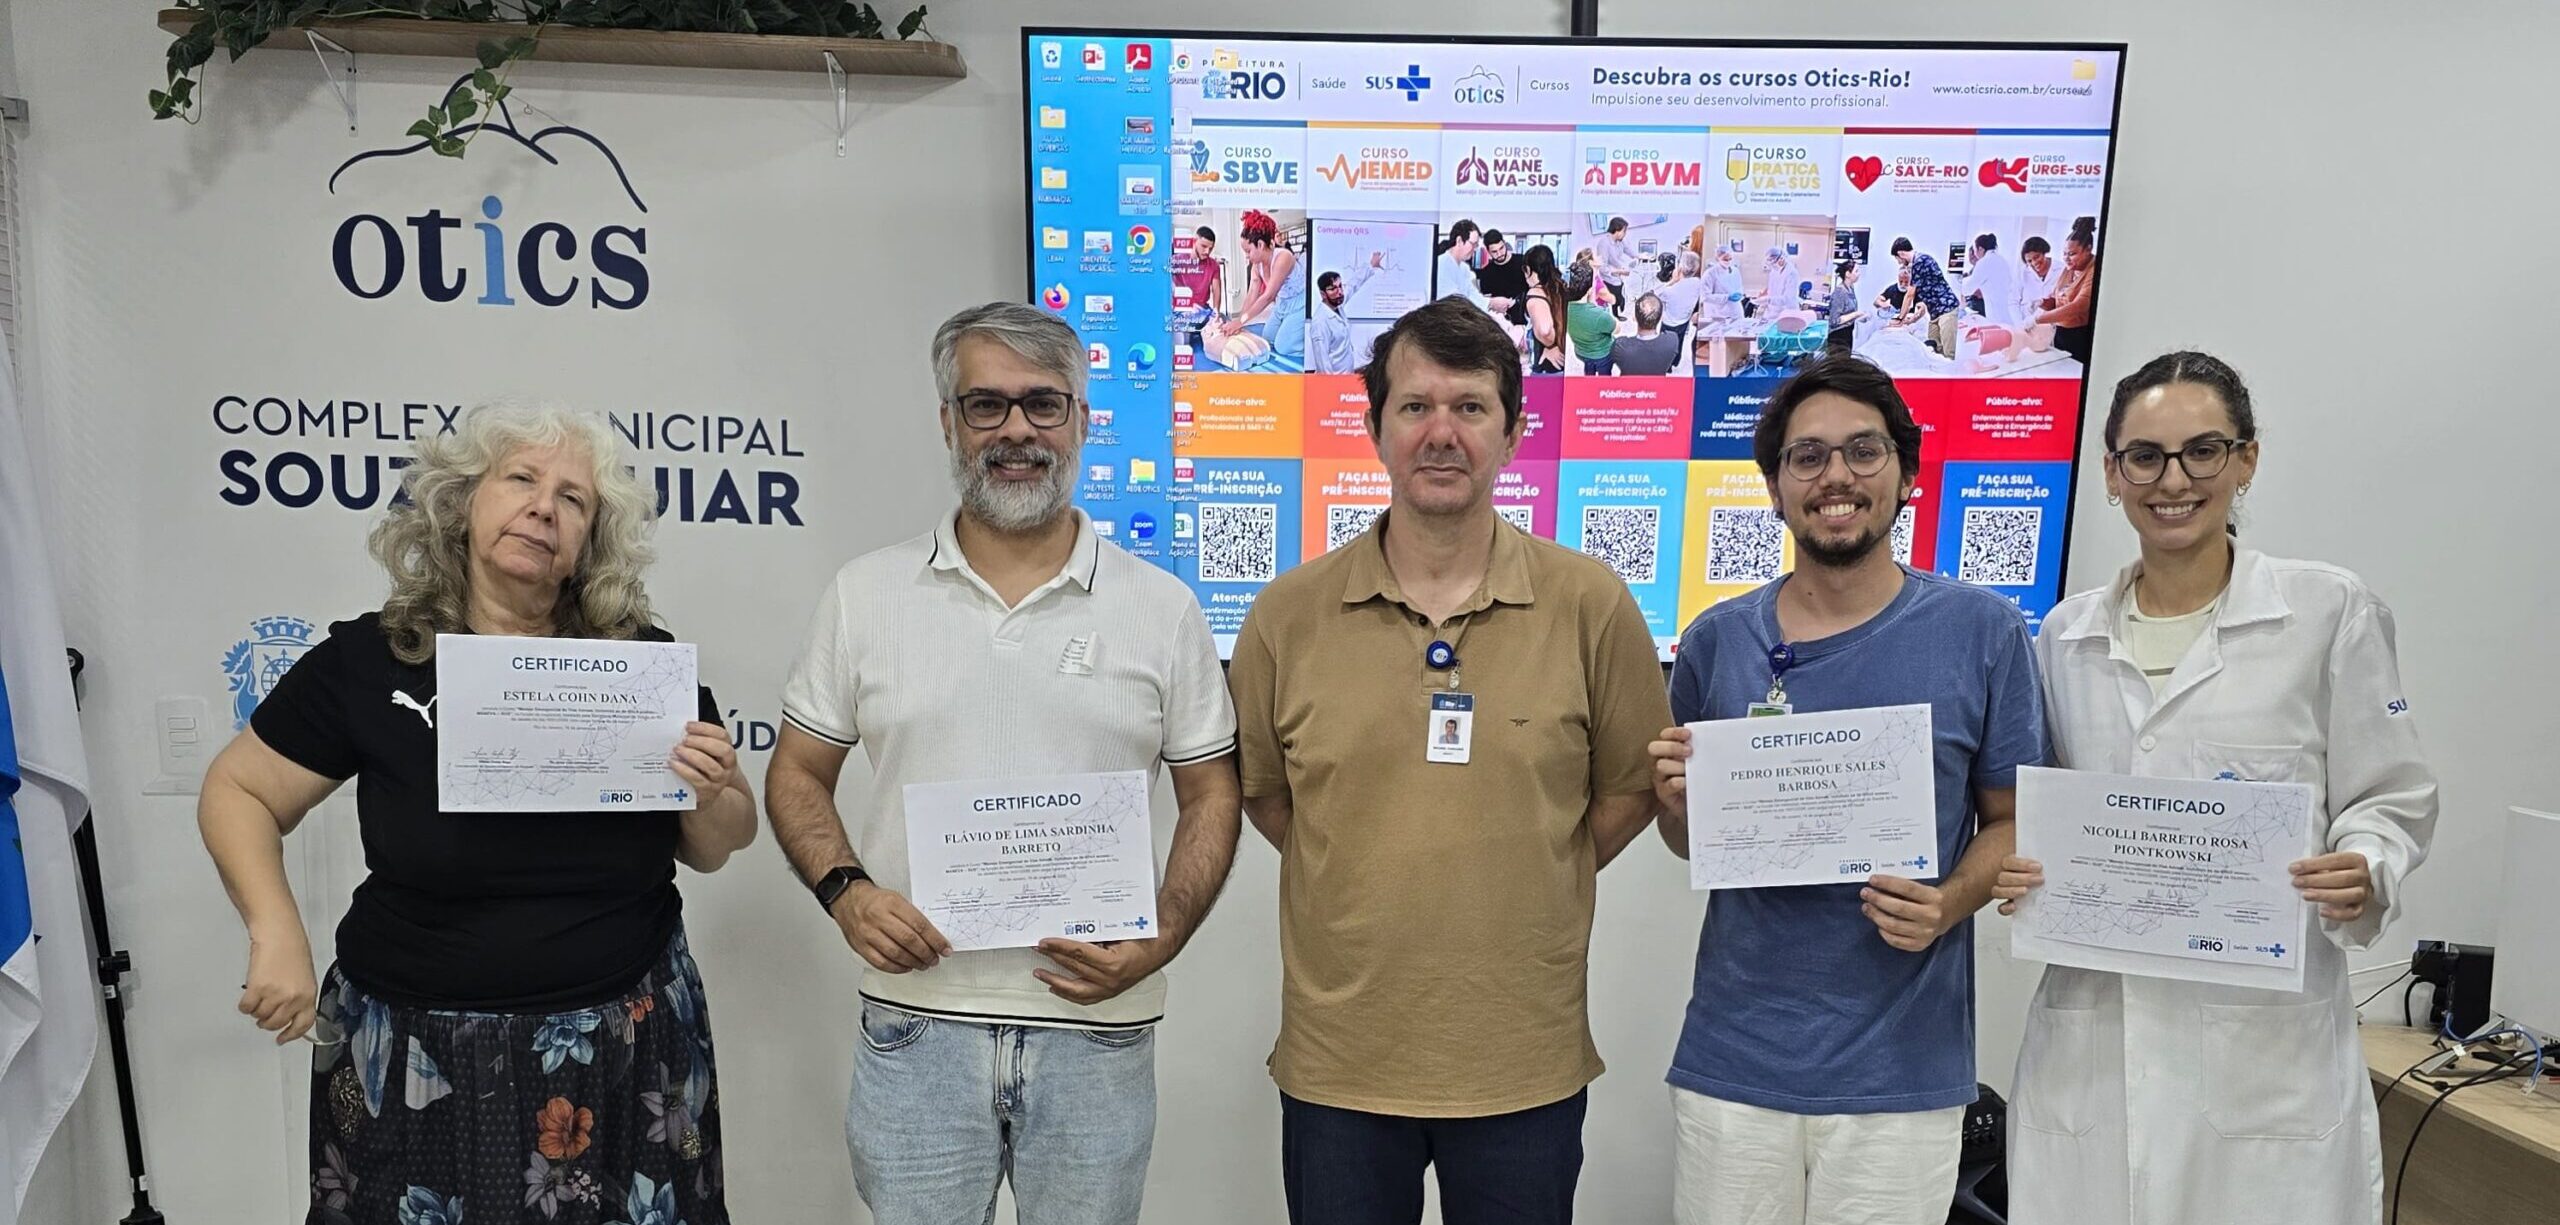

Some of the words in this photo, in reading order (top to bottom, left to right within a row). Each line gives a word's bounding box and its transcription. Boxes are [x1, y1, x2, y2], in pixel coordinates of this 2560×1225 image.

[1202, 59, 1285, 68] PEITURA
[1311, 77, 1346, 89] Saúde
[1365, 76, 1394, 90] SUS
[1592, 66, 1692, 87] Descubra
[1699, 71, 1722, 87] os
[1728, 71, 1798, 88] cursos
[1804, 68, 1911, 89] Otics-Rio!
[1231, 71, 1286, 100] RIO
[1530, 79, 1570, 91] Cursos
[1454, 85, 1505, 104] otics
[1591, 93, 1663, 108] Impulsione
[1667, 95, 1690, 106] seu
[1694, 93, 1807, 107] desenvolvimento
[1810, 94, 1889, 109] profissional.
[1224, 147, 1272, 158] CURSO
[1361, 148, 1408, 159] CURSO
[1494, 147, 1540, 158] CURSO
[1612, 149, 1660, 160] CURSO
[1753, 147, 1806, 160] CURSO
[2032, 155, 2066, 163] CURSO
[1493, 159, 1543, 172] MANE
[1896, 156, 1930, 165] CURSO
[1223, 161, 1298, 184] SBVE
[1360, 161, 1433, 181] IEMED
[1610, 162, 1702, 186] PBVM
[1895, 165, 1969, 177] SAVE-RIO
[2032, 164, 2102, 176] URGE-SUS
[1493, 174, 1559, 187] VA-SUS
[1752, 176, 1821, 189] VA-SUS
[331, 195, 649, 310] otics
[1599, 390, 1656, 400] Público-alvo:
[1985, 397, 2043, 406] Público-alvo:
[213, 395, 462, 441] COMPLEX
[608, 410, 805, 457] NICIPAL
[219, 449, 418, 511] SOUZ
[1208, 470, 1242, 483] FAÇA
[1242, 471, 1266, 481] SUA
[1338, 472, 1369, 484] FAÇA
[1499, 473, 1523, 483] SUA
[1595, 474, 1626, 486] FAÇA
[1627, 474, 1650, 484] SUA
[1978, 475, 2009, 488] FAÇA
[2010, 475, 2033, 485] SUA
[1322, 483, 1392, 499] PRÉ-INSCRIÇ
[1578, 485, 1668, 499] PRÉ-INSCRIÇÃO
[1961, 486, 2049, 500] PRÉ-INSCRIÇÃO
[512, 657, 628, 673] CERTIFICADO
[503, 691, 555, 702] ESTELA
[600, 693, 638, 704] DANA
[2387, 698, 2408, 715] SU
[1750, 729, 1862, 750] CERTIFICADO
[1730, 768, 1773, 781] PEDRO
[1776, 764, 1842, 778] HENRIQUE
[1845, 760, 1887, 773] SALES
[1778, 779, 1838, 793] BARBOSA
[611, 793, 633, 803] RIO
[973, 793, 1082, 812] CERTIFICADO
[2106, 793, 2225, 816] CERTIFICADO
[944, 830, 992, 844] FLÁVIO
[995, 829, 1012, 841] DE
[1015, 827, 1047, 840] LIMA
[1050, 824, 1115, 838] SARDINHA
[2082, 824, 2137, 841] NICOLLI
[2140, 831, 2207, 847] BARRETO
[2210, 837, 2249, 850] ROSA
[1001, 842, 1061, 856] BARRETO
[2113, 844, 2212, 863] PIONTKOWSKI
[1850, 863, 1872, 874] RIO
[1075, 923, 1096, 934] RIO
[2200, 939, 2223, 952] RIO
